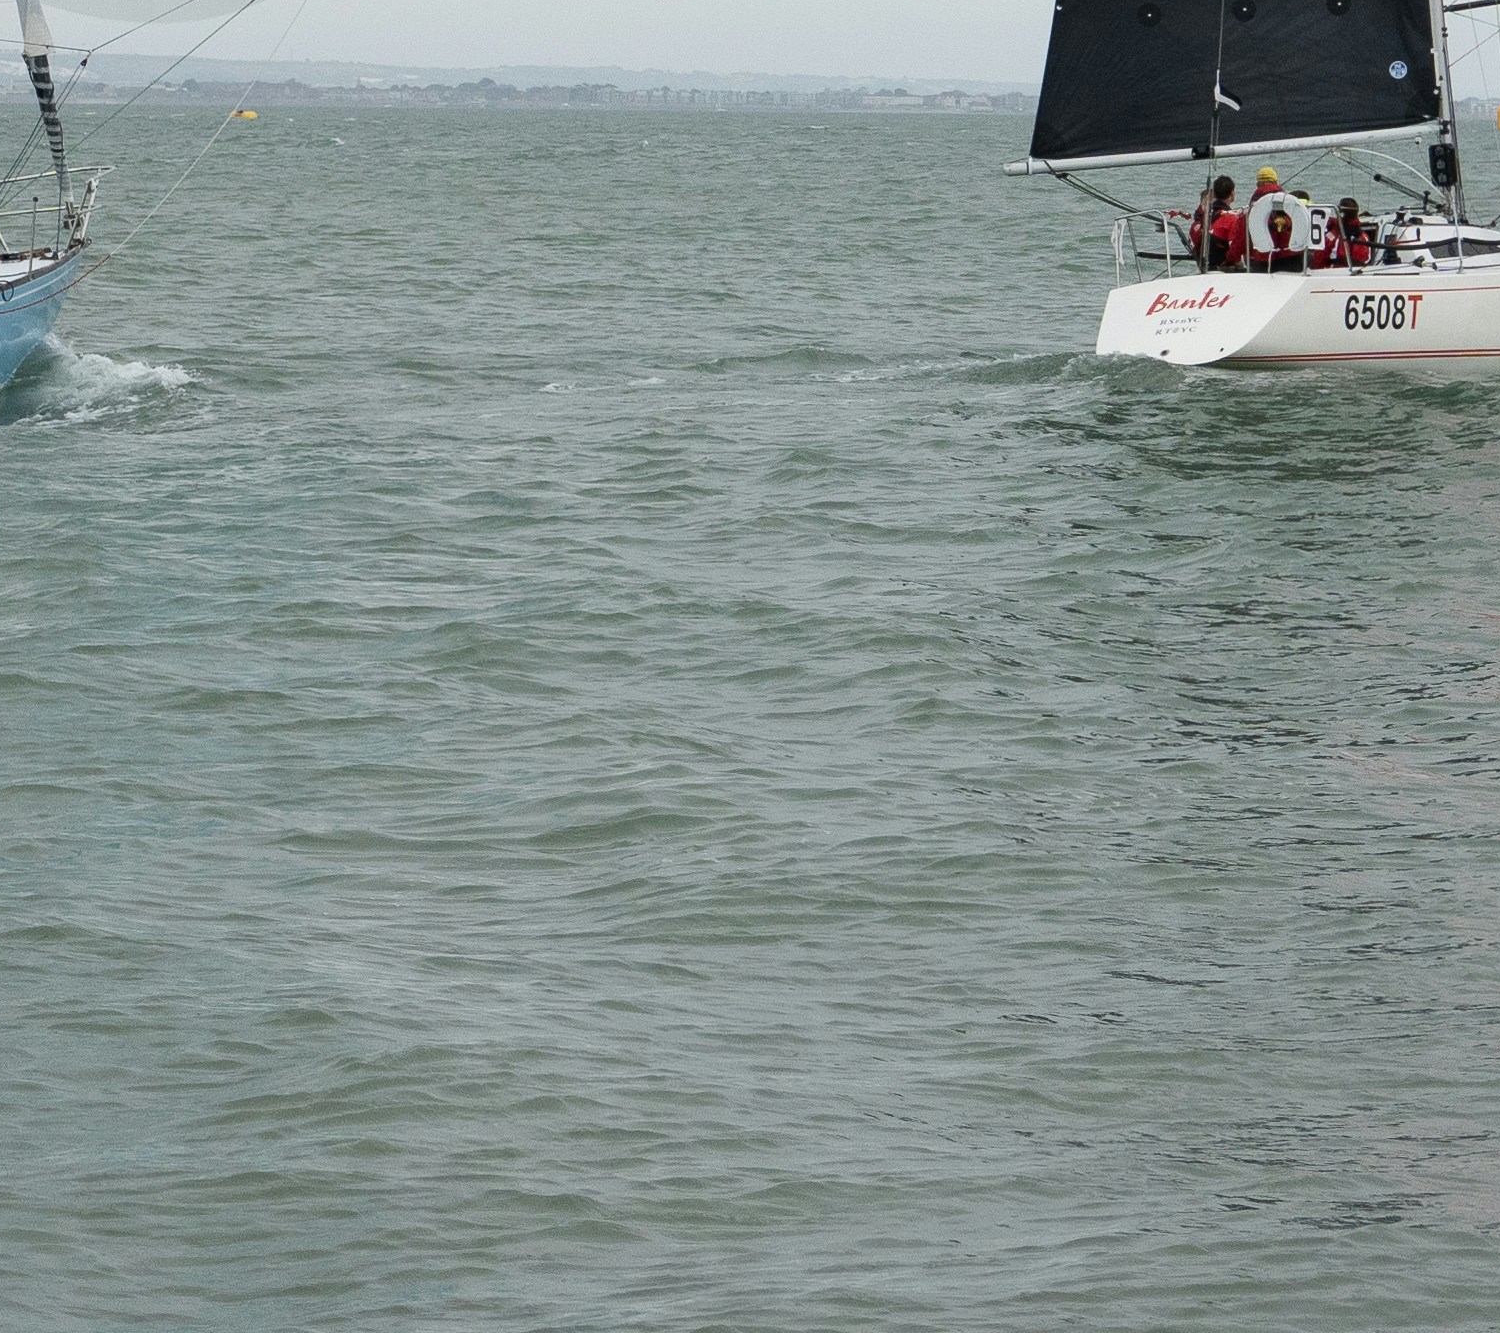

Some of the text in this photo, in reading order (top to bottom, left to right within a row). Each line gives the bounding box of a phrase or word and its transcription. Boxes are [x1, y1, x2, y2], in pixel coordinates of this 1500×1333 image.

[1311, 208, 1326, 245] 6
[1145, 286, 1234, 316] Banter
[1344, 294, 1423, 330] 6508T
